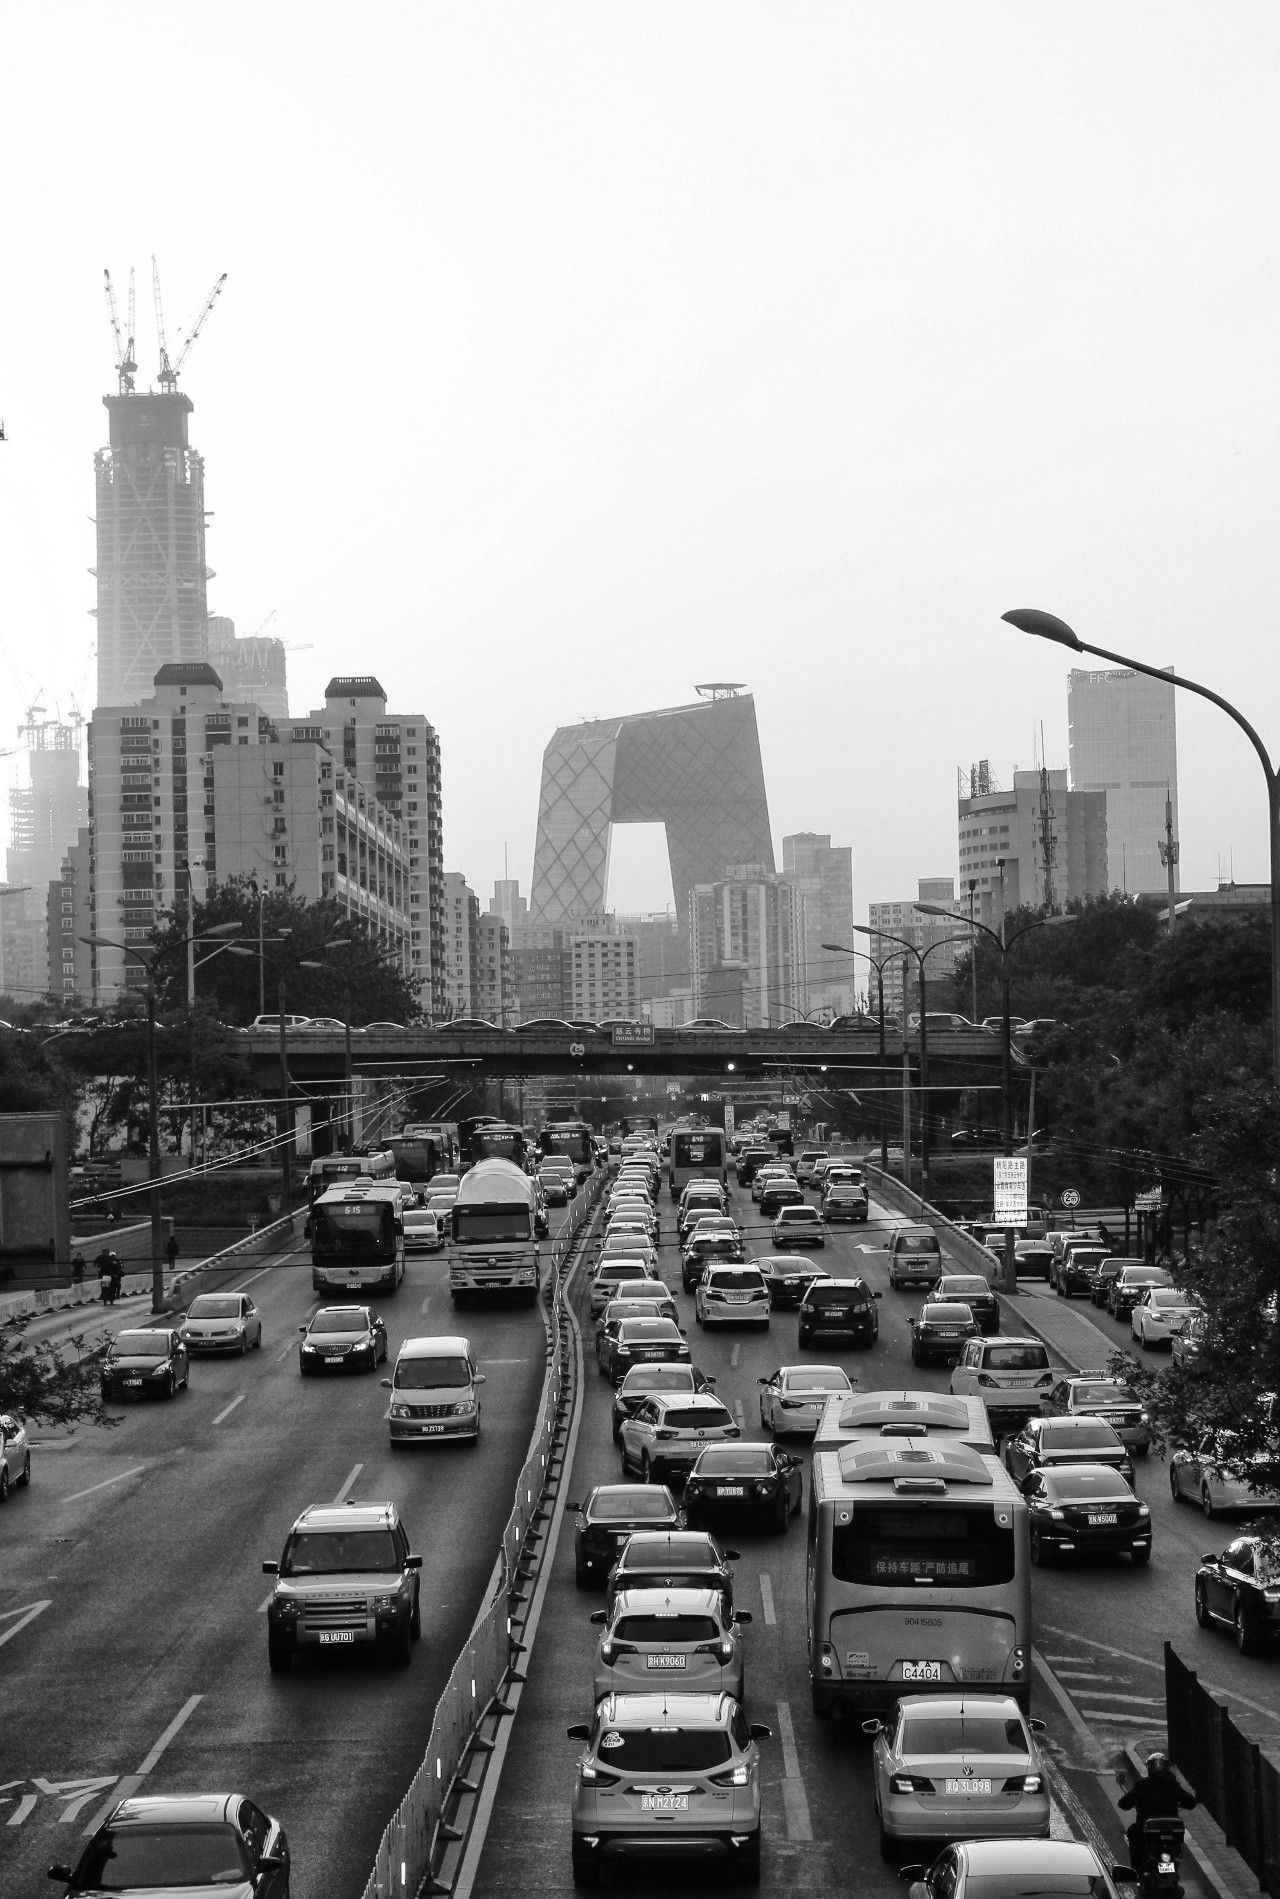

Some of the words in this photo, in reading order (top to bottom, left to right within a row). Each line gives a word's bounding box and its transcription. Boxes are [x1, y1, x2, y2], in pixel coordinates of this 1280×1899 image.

[1089, 673, 1112, 684] FFC
[344, 1206, 361, 1215] 615
[876, 1561, 920, 1574] 保持车距
[924, 1561, 969, 1575] 严防追尾
[904, 1617, 942, 1627] 90415805
[904, 1668, 939, 1679] C4404
